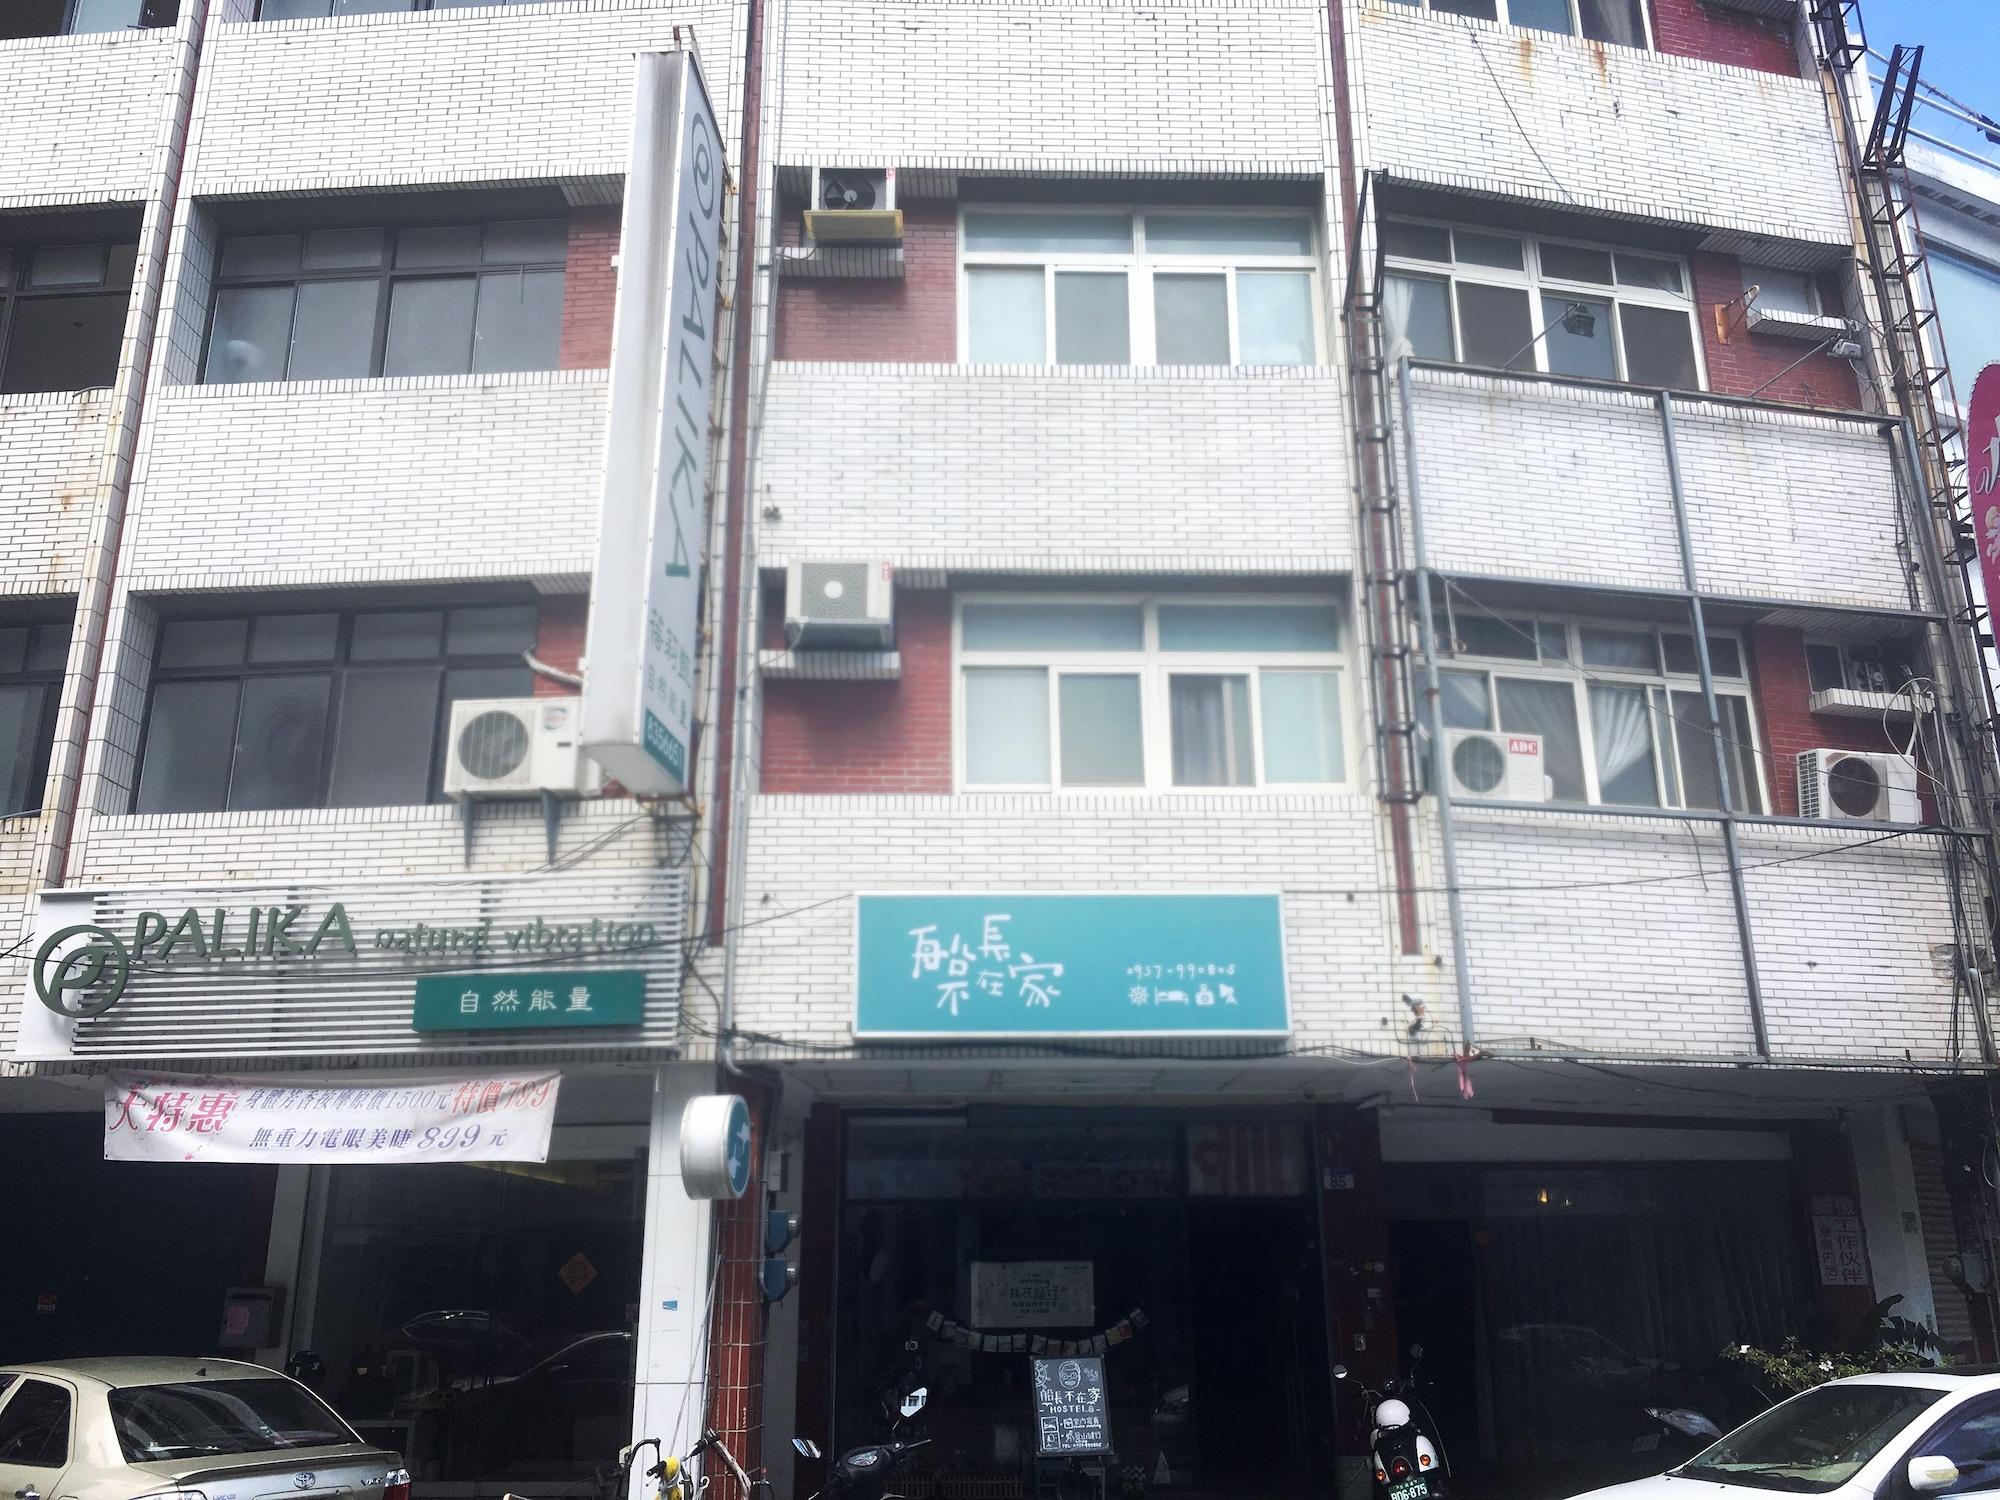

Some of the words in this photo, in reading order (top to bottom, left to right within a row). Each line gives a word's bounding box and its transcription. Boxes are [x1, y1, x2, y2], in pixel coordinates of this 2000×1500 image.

[665, 212, 711, 579] PALIKA
[128, 902, 356, 962] PALIKA
[374, 917, 495, 956] natural
[504, 914, 659, 953] vibration
[1126, 963, 1237, 980] 0937-990805
[459, 985, 594, 1015] 自然能量
[108, 1084, 241, 1133] 大特惠
[249, 1126, 413, 1149] 無重力電眼美睫
[417, 1123, 482, 1150] 899
[489, 1128, 509, 1147] 元
[1330, 1175, 1346, 1188] 85
[1833, 1218, 1864, 1283] 工作伙伴
[1040, 1387, 1102, 1404] 船長不在家
